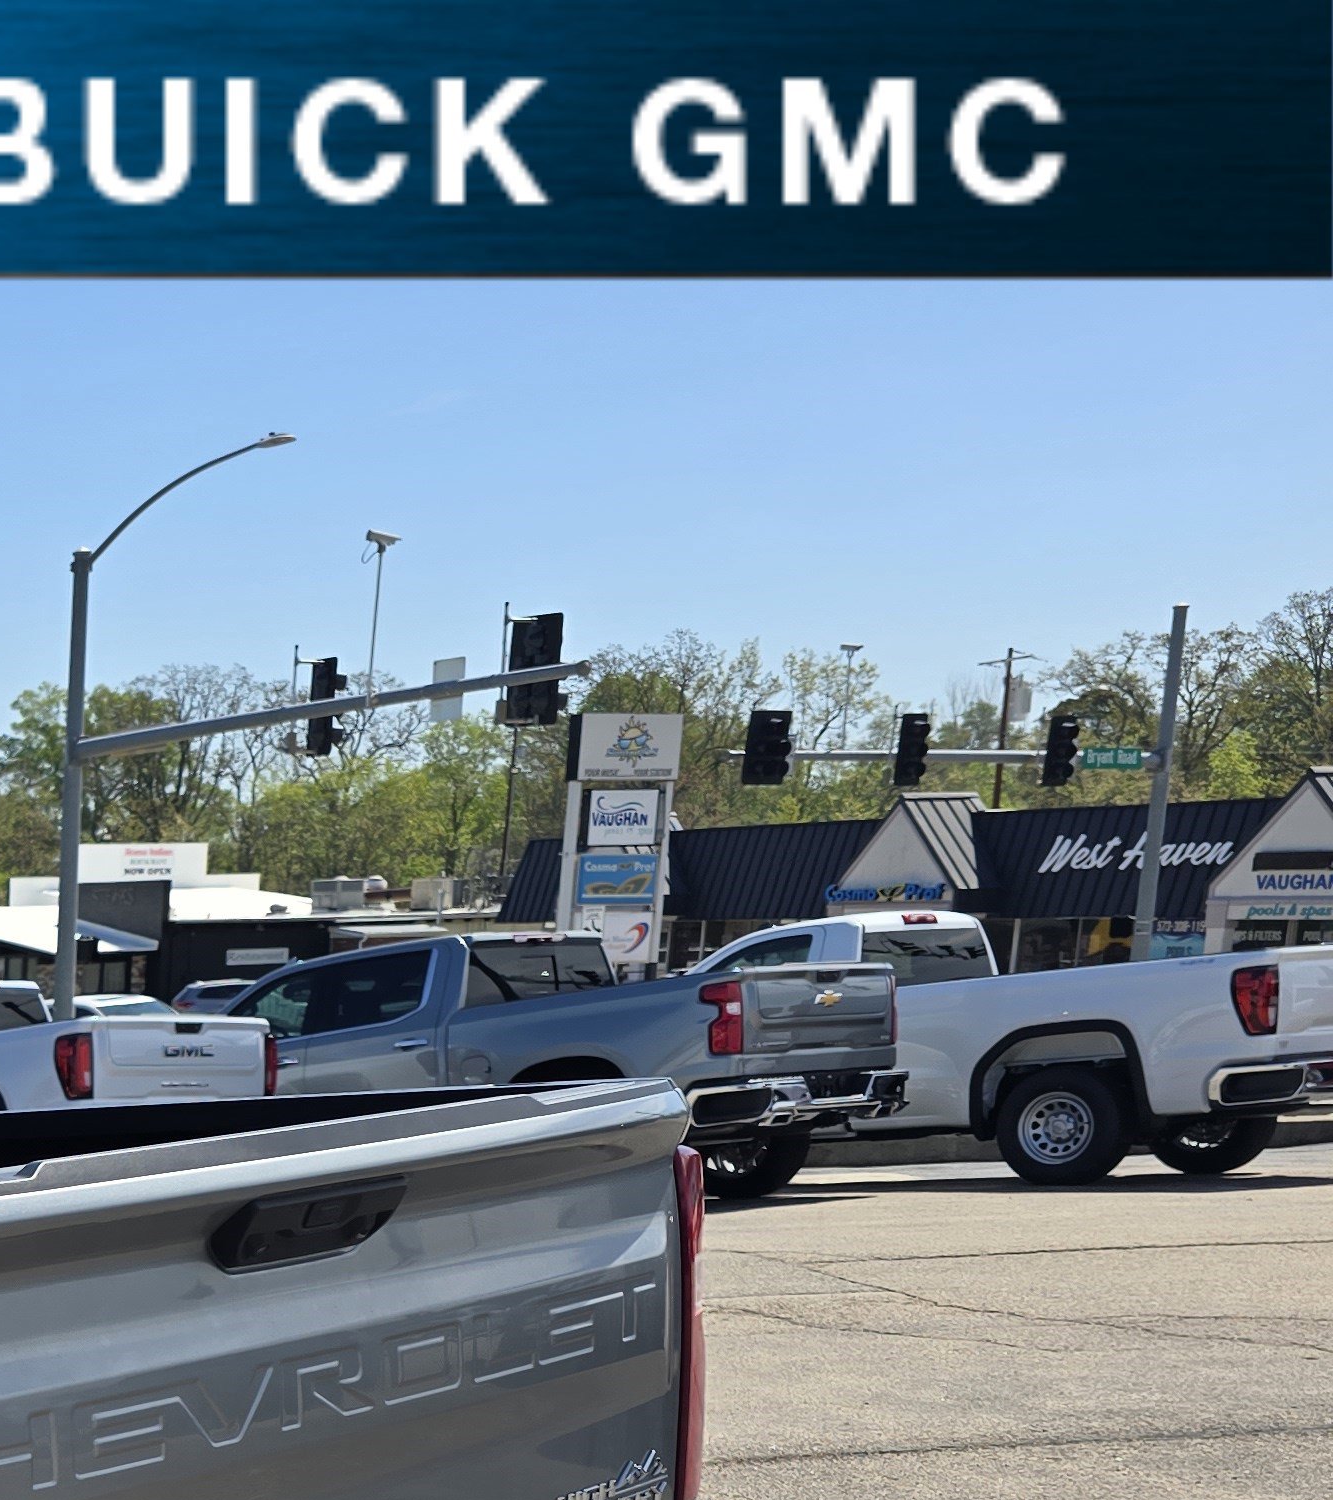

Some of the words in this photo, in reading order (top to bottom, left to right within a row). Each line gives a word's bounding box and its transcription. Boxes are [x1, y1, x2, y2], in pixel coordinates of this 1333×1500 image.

[1086, 749, 1115, 767] Bryant
[1116, 749, 1138, 765] Road
[591, 812, 649, 827] VAUGHAN
[1038, 834, 1122, 873] West
[1118, 830, 1234, 870] Haven
[124, 867, 146, 876] NOW
[147, 867, 171, 876] OPEN
[585, 861, 618, 872] Cosmo
[634, 861, 656, 872] Prof
[825, 884, 877, 901] Cosmo
[905, 883, 945, 900] Prof
[1246, 903, 1285, 919] pools
[1287, 903, 1298, 916] &
[1300, 905, 1333, 919] spas
[164, 1044, 215, 1058] GMC
